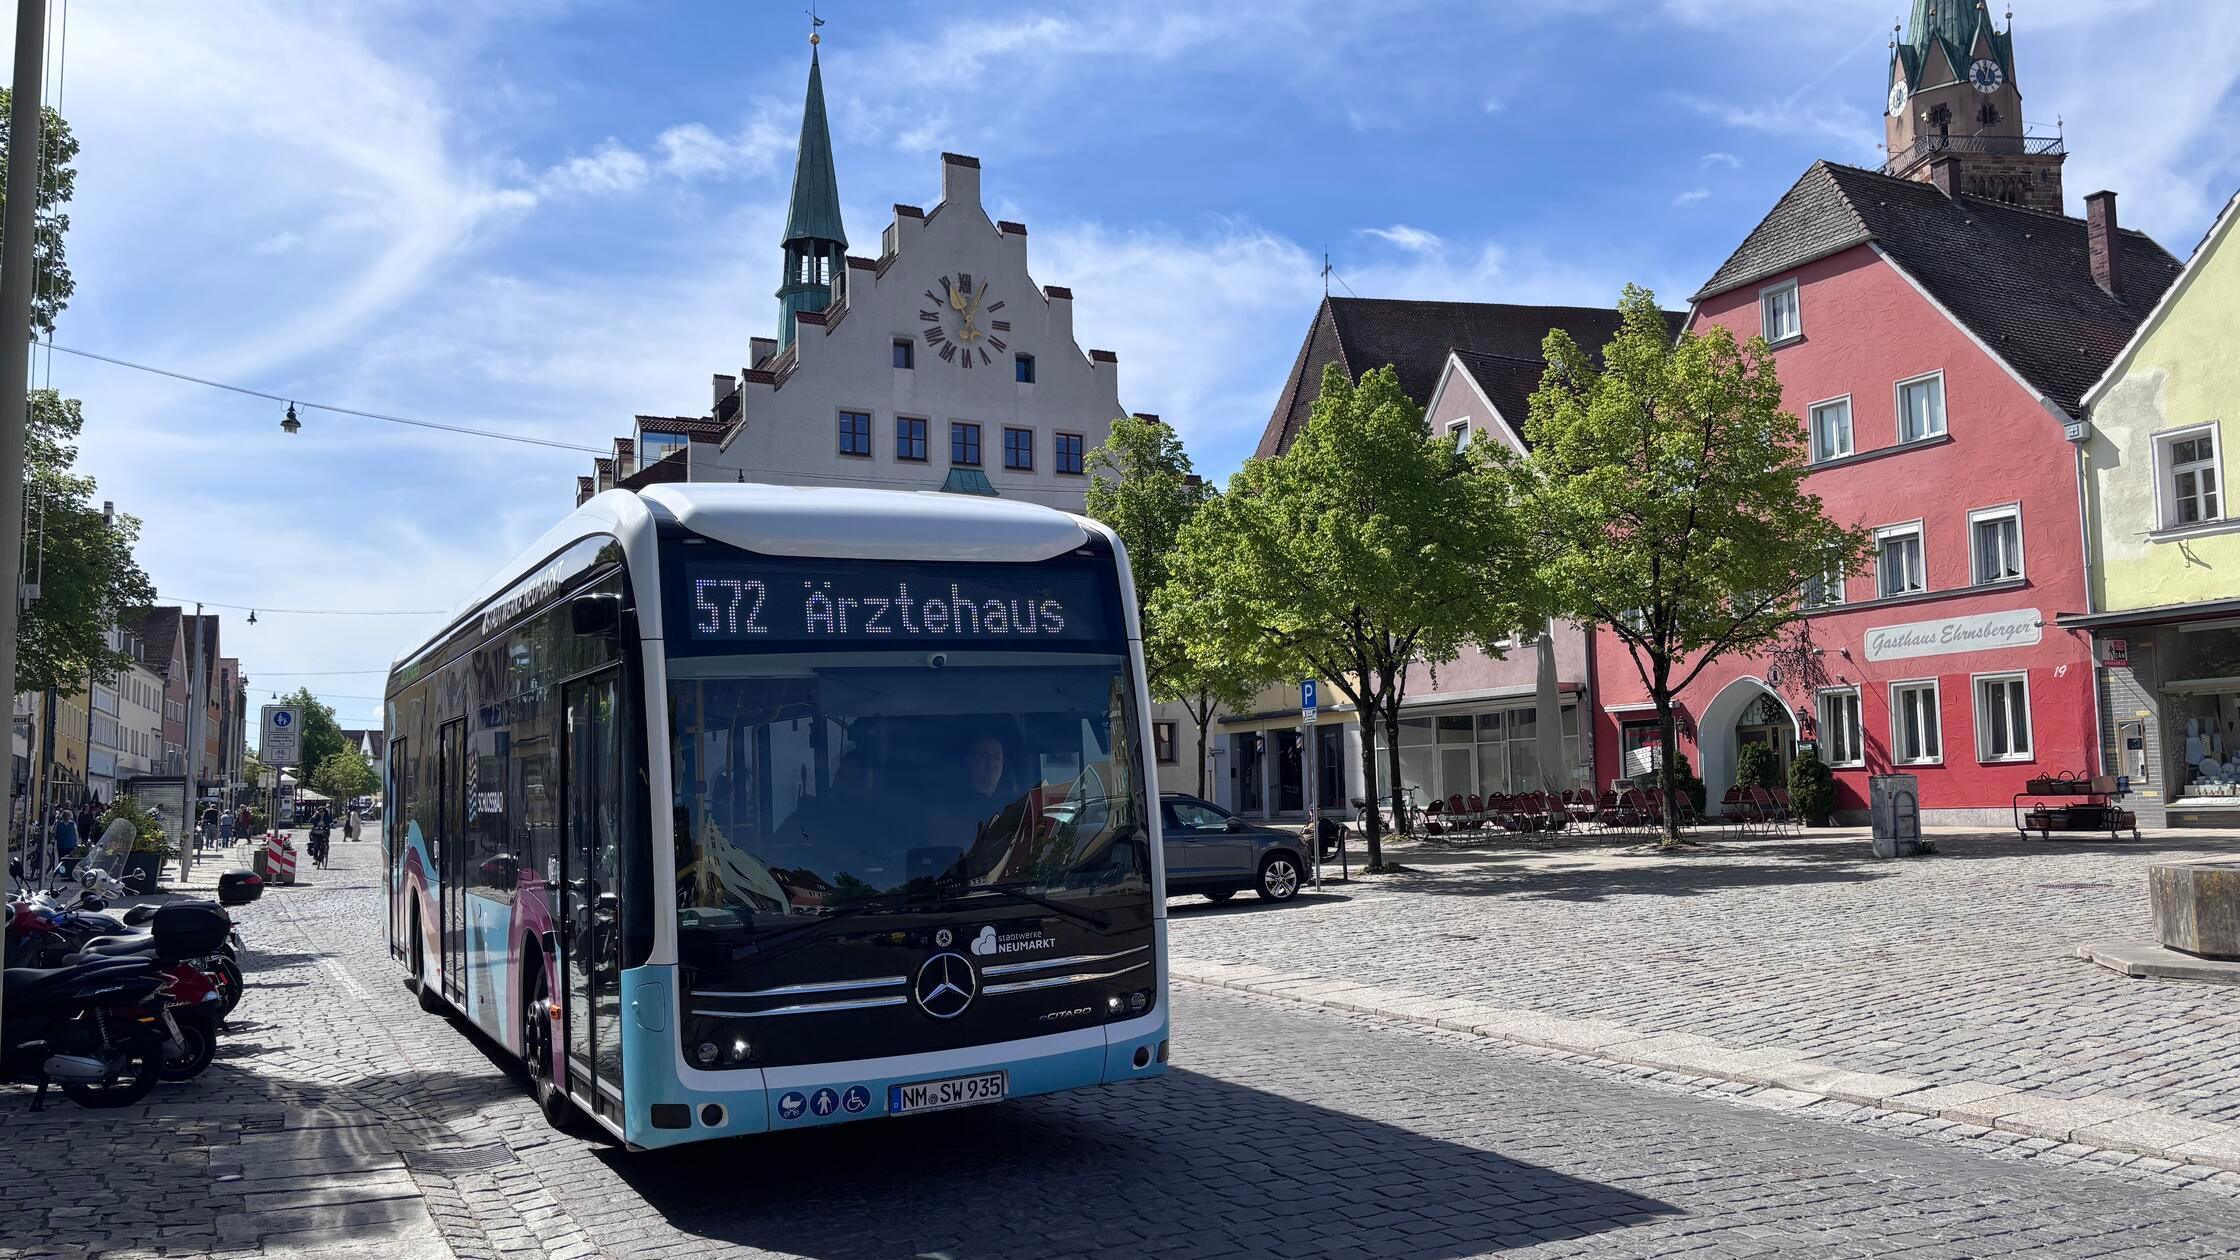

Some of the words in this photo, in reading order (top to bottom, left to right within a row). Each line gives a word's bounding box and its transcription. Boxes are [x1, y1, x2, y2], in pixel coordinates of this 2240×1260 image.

[485, 587, 523, 633] STADTWERKE
[522, 559, 565, 611] NEUMARKT
[695, 579, 769, 633] 572
[804, 580, 1065, 633] Ärztehaus
[1872, 632, 1936, 656] Gasthaus
[1939, 620, 2032, 645] Ehrnsberger
[2053, 664, 2068, 678] 19
[1304, 684, 1313, 705] P
[477, 791, 504, 813] SCHLOSSBAD
[998, 930, 1042, 943] stadtwerke
[998, 938, 1056, 953] NEUMARKT
[902, 1086, 927, 1108] NM
[940, 1081, 963, 1103] SW
[967, 1076, 1001, 1099] 935
